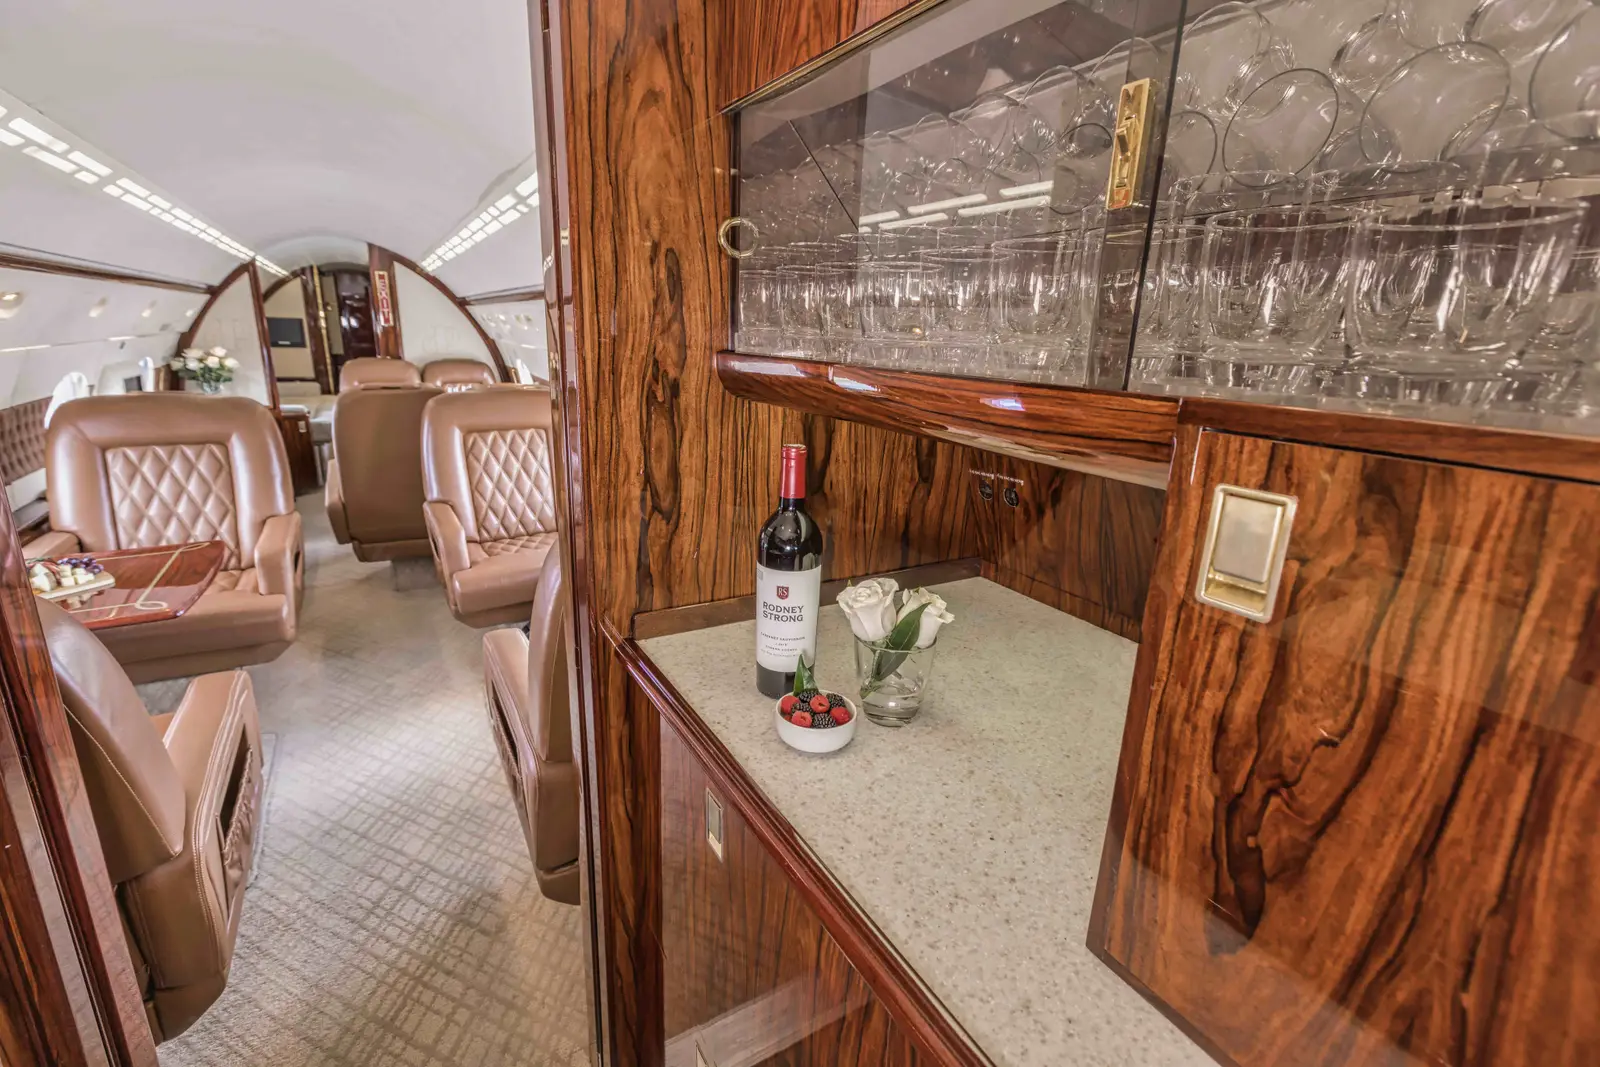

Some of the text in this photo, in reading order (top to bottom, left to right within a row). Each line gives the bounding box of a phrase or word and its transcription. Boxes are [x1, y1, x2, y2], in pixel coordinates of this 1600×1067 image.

[380, 279, 390, 318] EXIT
[763, 601, 804, 613] RODNEY
[763, 611, 804, 622] STRONG
